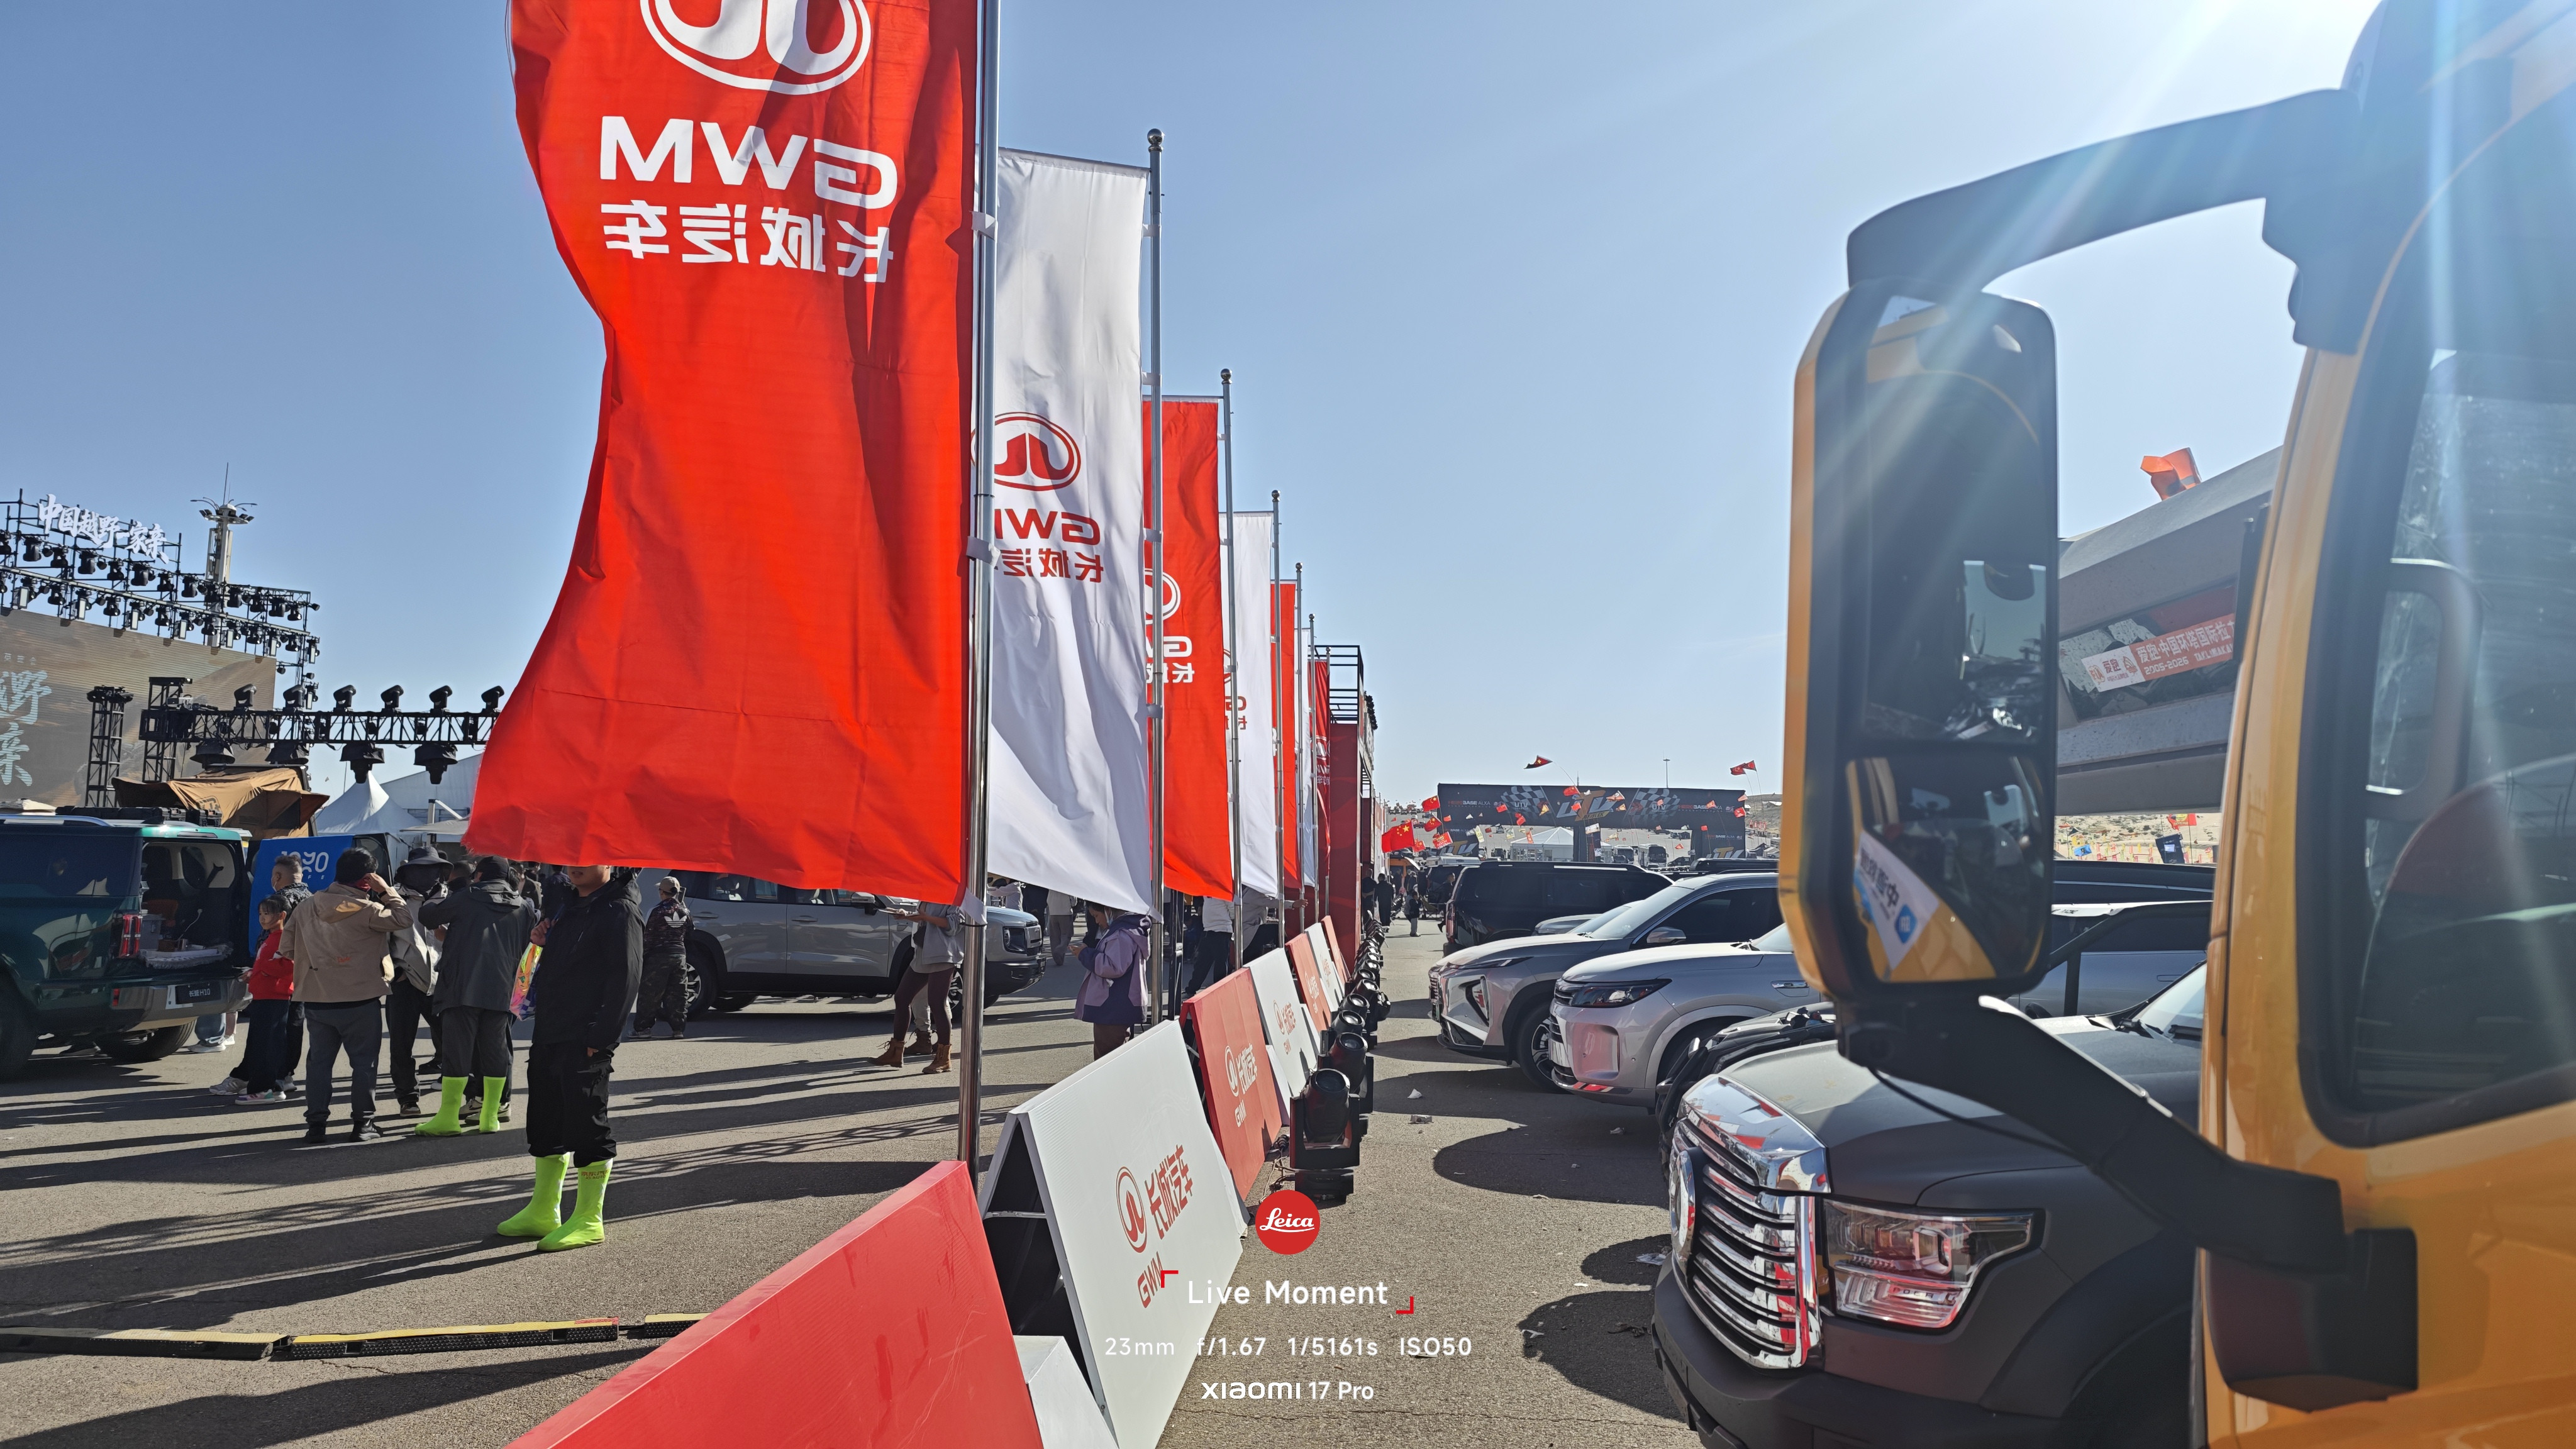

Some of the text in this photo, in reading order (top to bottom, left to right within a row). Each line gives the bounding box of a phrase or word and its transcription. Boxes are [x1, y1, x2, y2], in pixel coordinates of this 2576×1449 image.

[37, 493, 169, 564] 中国越野一家亲
[2144, 657, 2189, 675] 2005-2026
[1144, 1144, 1193, 1240] 长城汽车
